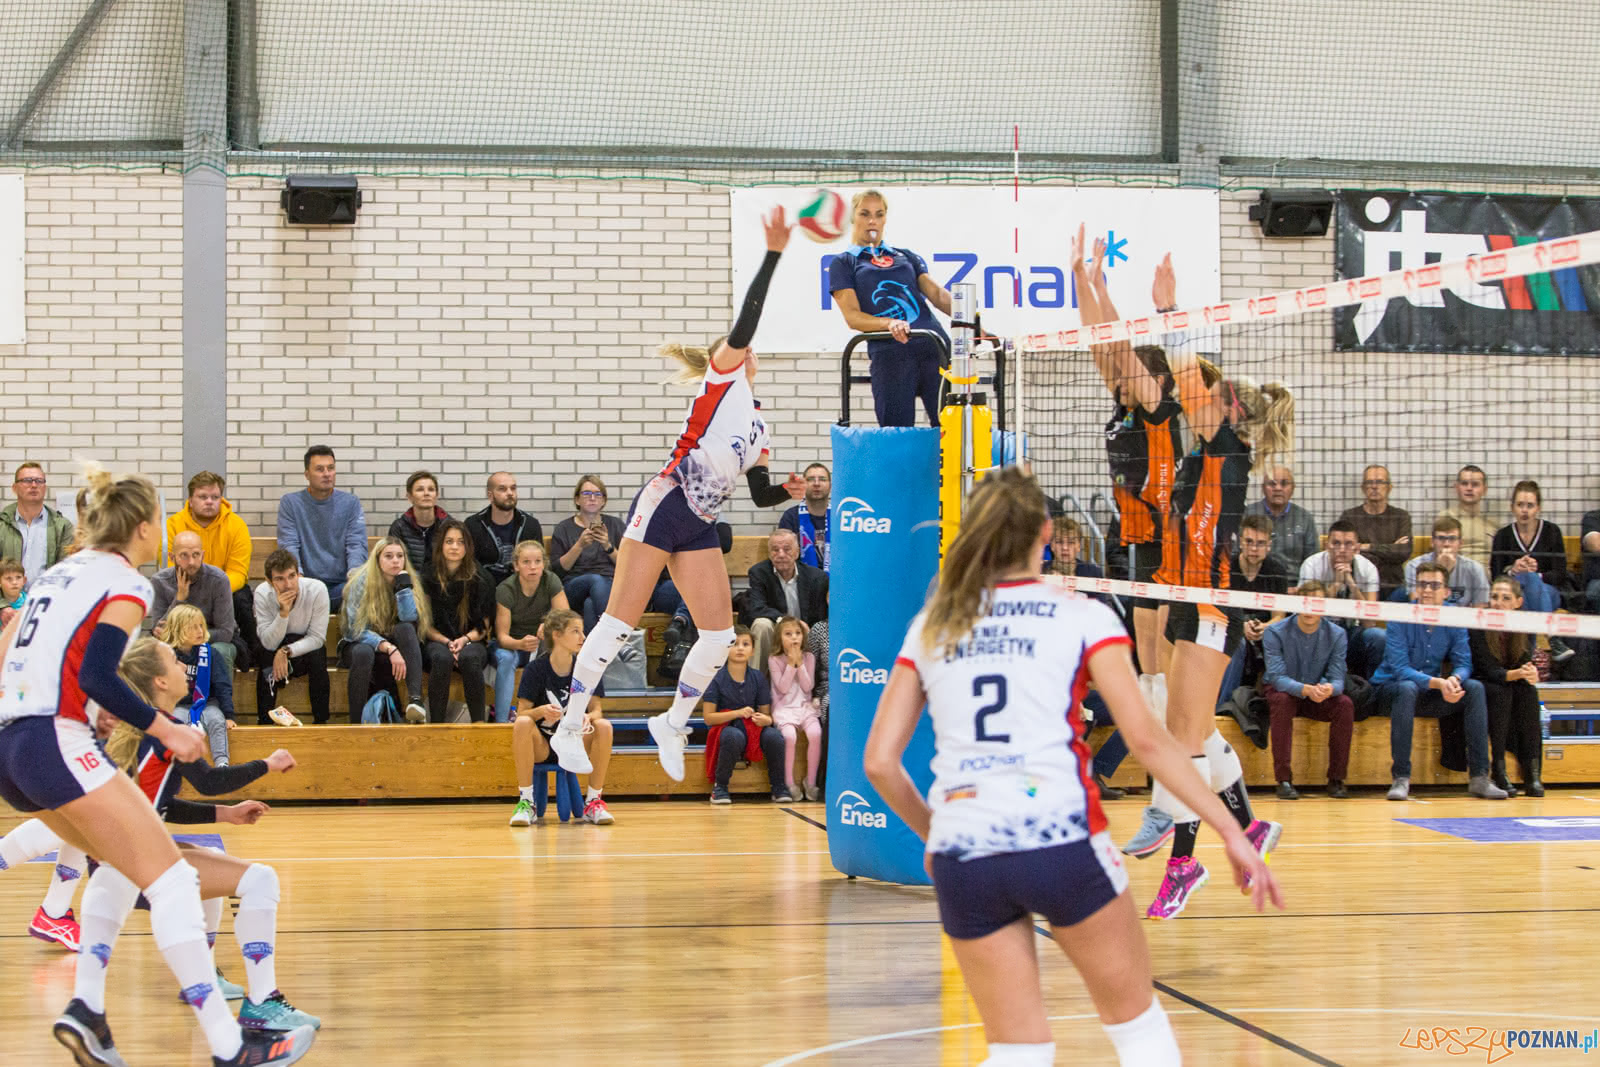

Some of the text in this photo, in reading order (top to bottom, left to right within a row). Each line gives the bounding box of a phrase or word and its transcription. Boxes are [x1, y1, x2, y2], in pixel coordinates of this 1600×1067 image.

[840, 510, 892, 534] Enea
[15, 596, 52, 649] 16
[840, 661, 888, 685] Enea
[972, 674, 1011, 744] 2
[74, 751, 100, 772] 16
[840, 803, 888, 829] Enea
